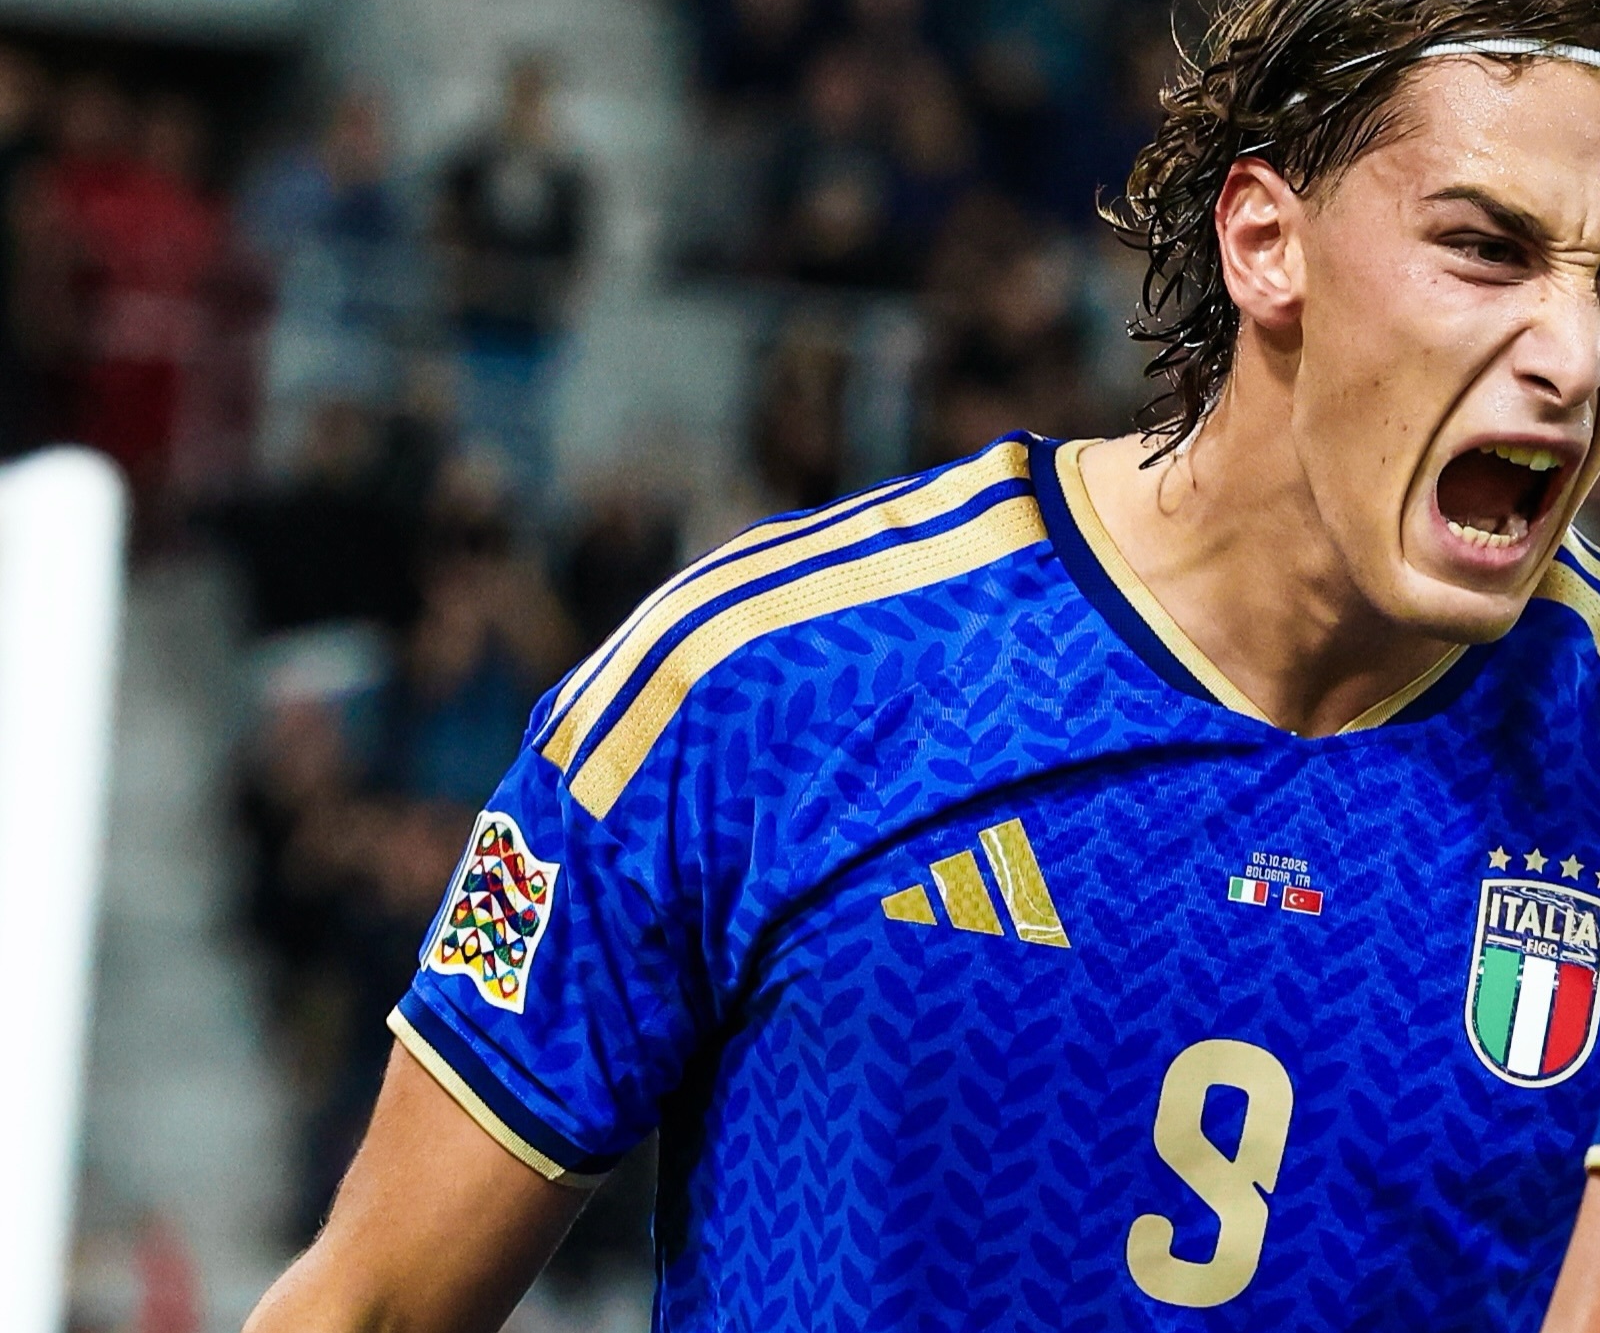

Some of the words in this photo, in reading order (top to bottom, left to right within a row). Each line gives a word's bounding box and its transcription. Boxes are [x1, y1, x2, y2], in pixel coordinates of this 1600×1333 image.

[1252, 851, 1308, 873] 05.10.2026
[1245, 864, 1292, 886] BOLOGNA,
[1295, 874, 1311, 888] ITA
[1488, 892, 1599, 950] ITALIA
[1525, 937, 1559, 958] FIGC
[1126, 1038, 1294, 1309] 9
